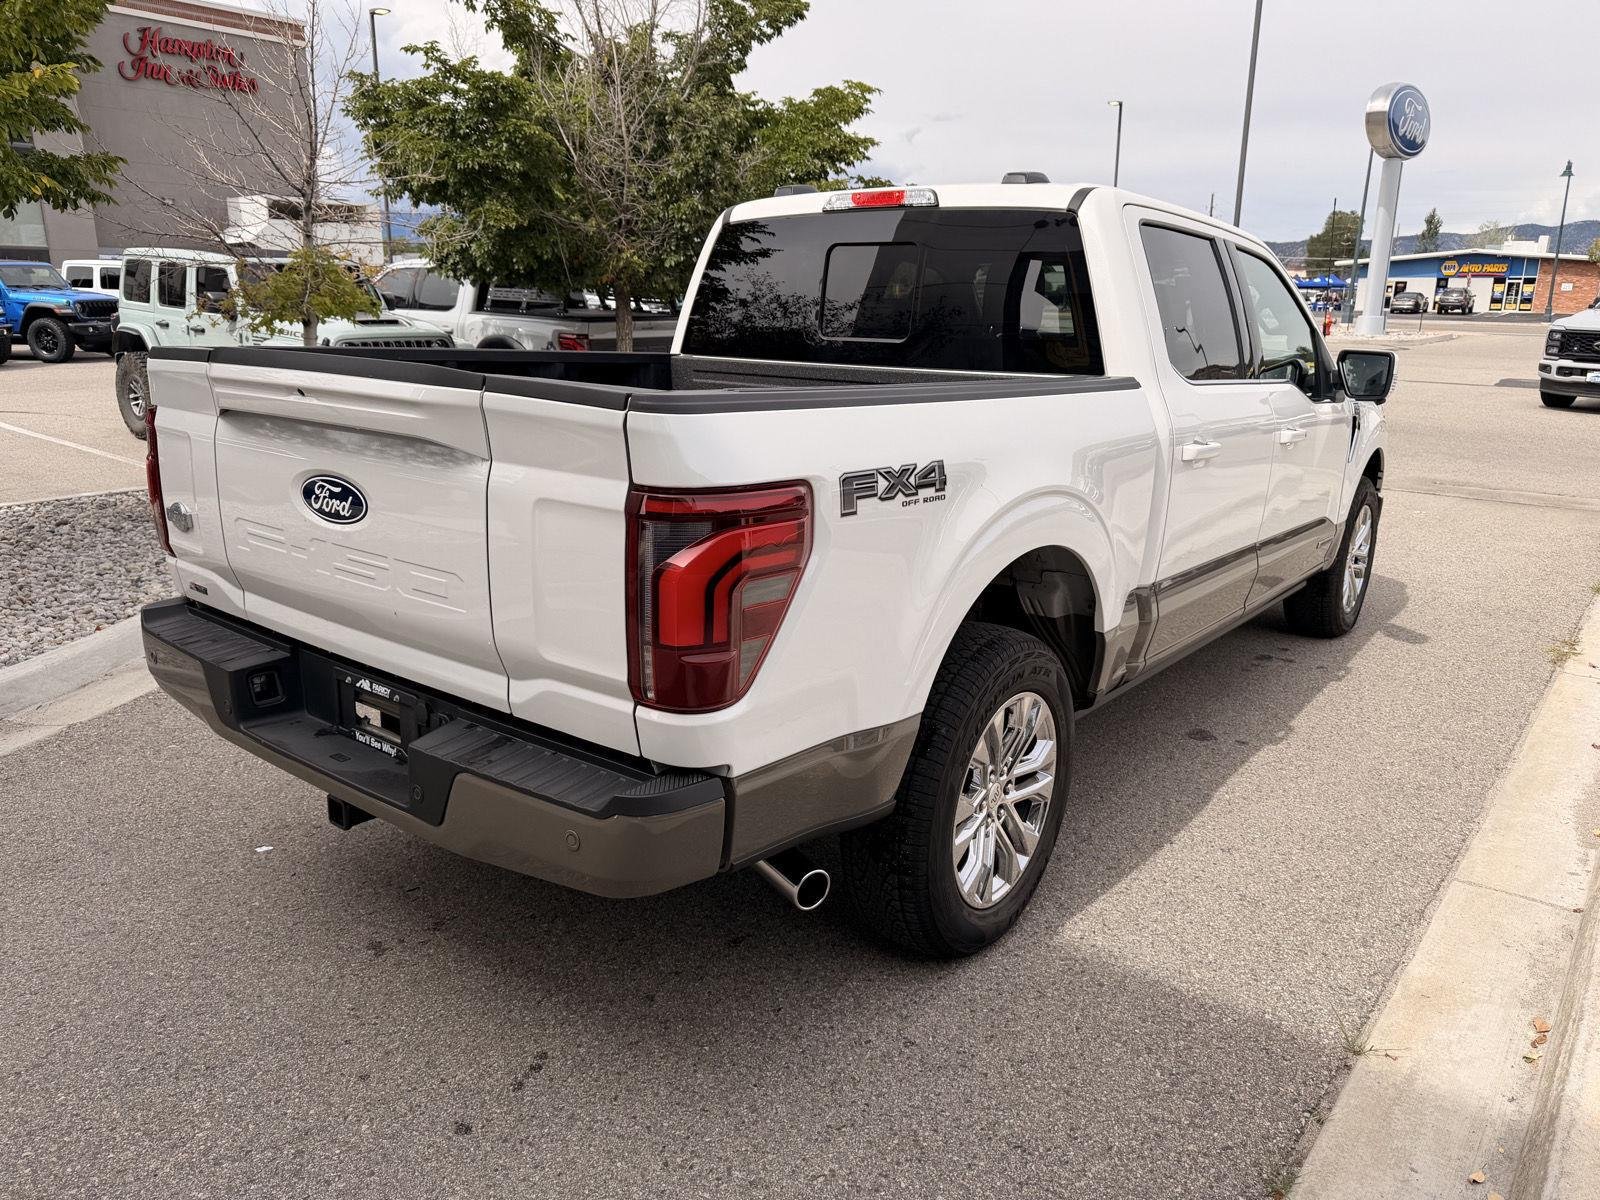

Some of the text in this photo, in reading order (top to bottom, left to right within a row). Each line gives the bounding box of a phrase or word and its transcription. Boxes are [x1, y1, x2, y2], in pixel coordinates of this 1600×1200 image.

[123, 26, 238, 68] Hampton
[118, 56, 177, 86] Inn
[1398, 98, 1427, 144] Ford
[1459, 264, 1482, 273] AUTO
[1483, 263, 1508, 273] PARTS
[311, 481, 353, 516] Ford
[839, 460, 946, 517] FX4
[901, 494, 946, 507] OFF ROAD
[355, 730, 397, 757] You'll See Why!
